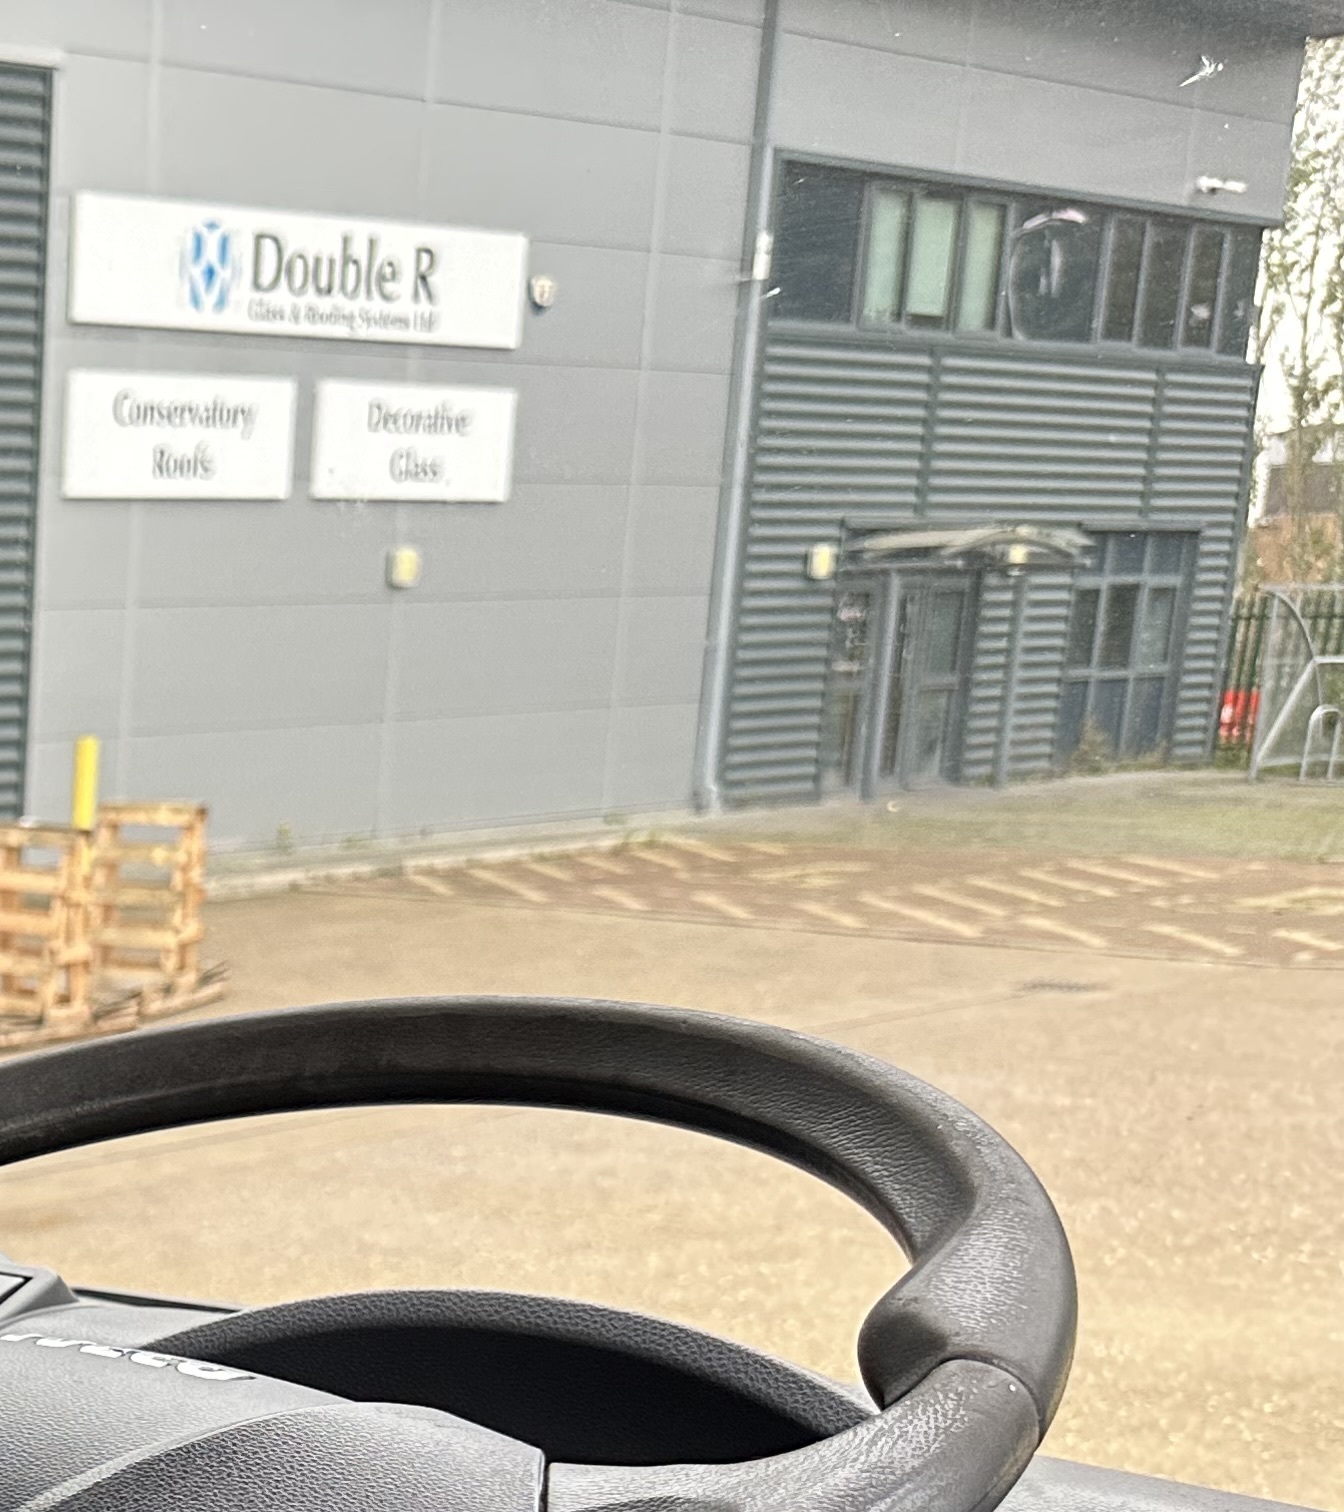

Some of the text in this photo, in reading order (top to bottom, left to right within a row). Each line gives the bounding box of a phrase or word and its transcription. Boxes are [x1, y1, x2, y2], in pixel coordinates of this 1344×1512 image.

[252, 231, 438, 305] Double R
[112, 388, 259, 440] Conservatory
[366, 397, 474, 437] Decorative
[151, 440, 216, 481] Roofs
[387, 444, 445, 484] Glass
